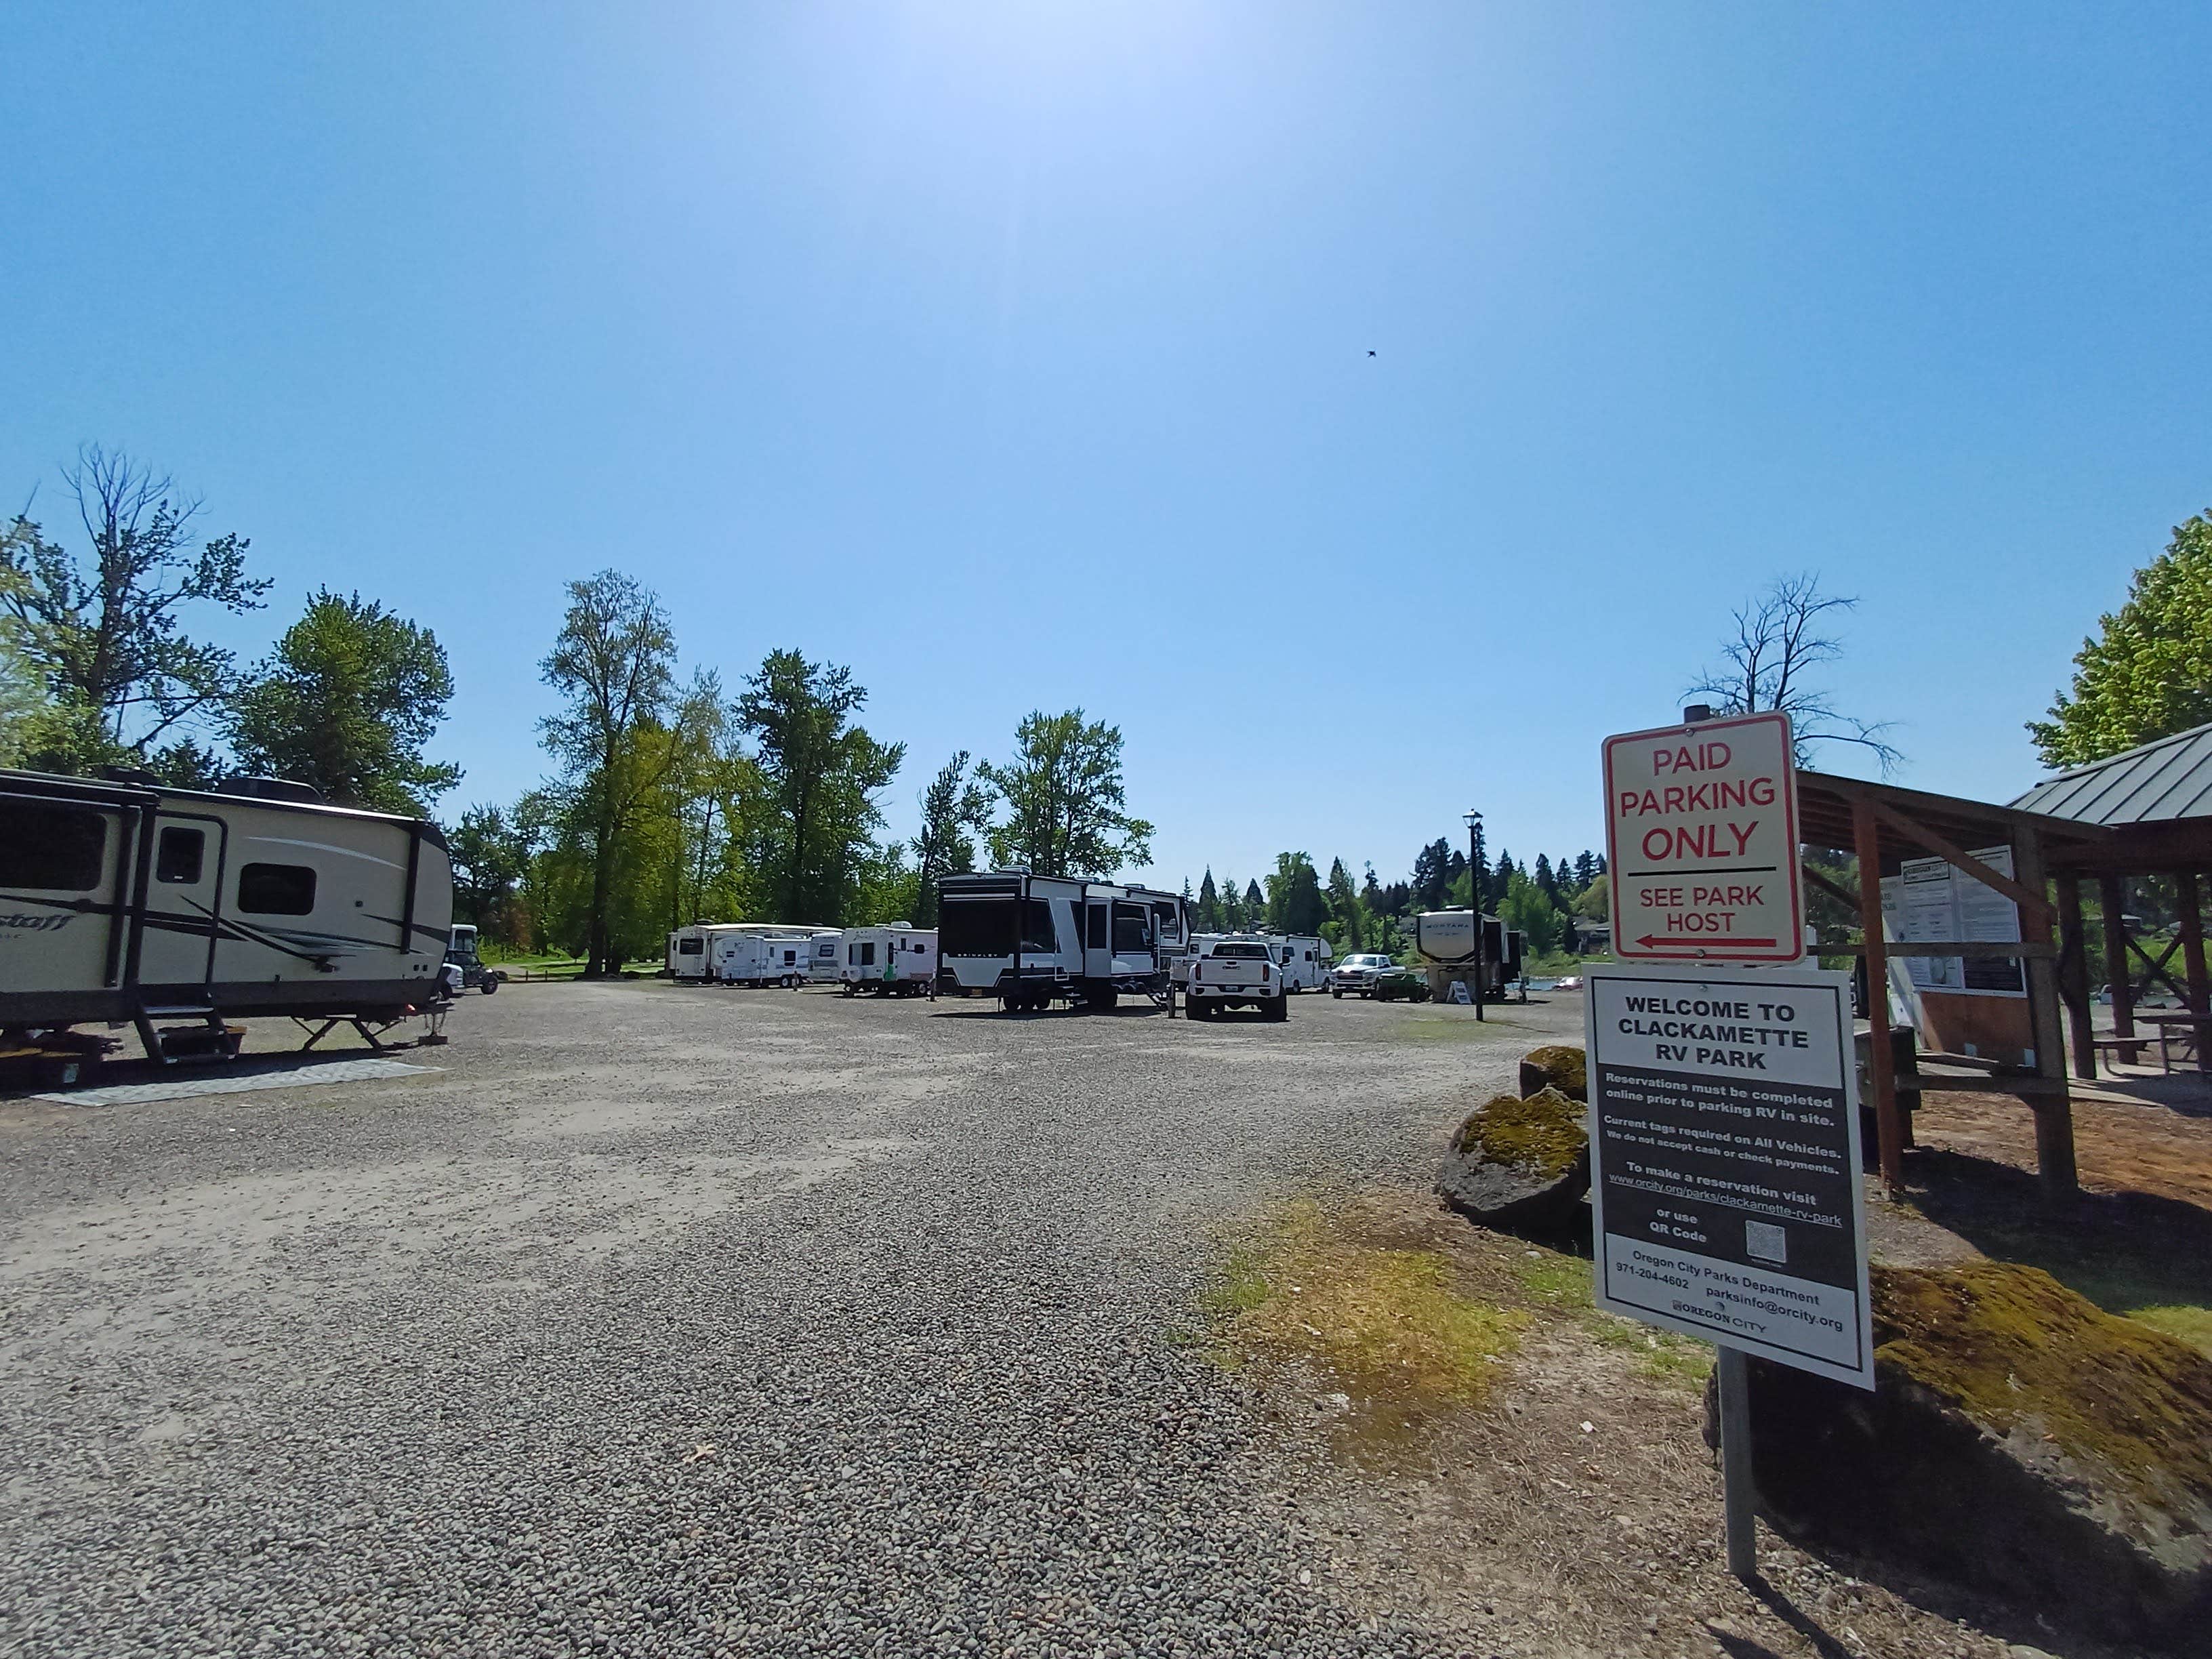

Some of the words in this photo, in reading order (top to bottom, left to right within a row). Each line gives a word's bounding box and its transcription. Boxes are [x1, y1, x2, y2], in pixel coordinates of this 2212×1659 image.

[1654, 742, 1732, 776] PAID
[1620, 777, 1775, 817] PARKING
[1642, 821, 1759, 861] ONLY
[1640, 888, 1683, 907] SEE
[1693, 885, 1764, 906] PARK
[1668, 912, 1735, 932] HOST
[1626, 996, 1750, 1019] WELCOME
[1757, 1003, 1795, 1022] TO
[1618, 1018, 1809, 1048] CLACKAMETTE
[1656, 1044, 1688, 1061] RV
[1696, 1048, 1767, 1069] PARK
[1605, 1073, 1688, 1091] Reservations
[1692, 1084, 1726, 1096] must
[1730, 1087, 1748, 1098] be
[1752, 1091, 1832, 1109] completed
[1606, 1089, 1643, 1101] online
[1647, 1094, 1677, 1105] prior
[1681, 1098, 1695, 1108] to
[1698, 1101, 1752, 1118] parking
[1756, 1107, 1777, 1118] RV
[1781, 1110, 1796, 1122] in
[1799, 1113, 1835, 1127] site.
[1604, 1115, 1647, 1129] Current
[1650, 1122, 1677, 1134] tags
[1679, 1127, 1732, 1142] required
[1734, 1136, 1751, 1145] on
[1755, 1137, 1773, 1148] All
[1776, 1140, 1842, 1159] Vehicles.
[1607, 1130, 1622, 1140] We
[1624, 1133, 1637, 1141] do
[1638, 1136, 1656, 1145] not
[1657, 1139, 1694, 1151] accept
[1695, 1145, 1721, 1156] cash
[1738, 1152, 1773, 1164] check
[1776, 1158, 1840, 1175] payments.
[1609, 1173, 1843, 1229] www.orcity.org/parks/clackamette-rv-park
[1626, 1161, 1643, 1172] To
[1645, 1166, 1681, 1180] make
[1684, 1174, 1693, 1183] a
[1696, 1178, 1779, 1199] reservation
[1782, 1191, 1817, 1206] visit
[1649, 1222, 1670, 1234] QR
[1672, 1227, 1708, 1243] Code
[1656, 1209, 1671, 1218] or
[1673, 1212, 1699, 1224] use
[1633, 1250, 1674, 1269] Oregon
[1677, 1262, 1701, 1277] City
[1704, 1268, 1739, 1285] Parks
[1742, 1277, 1820, 1306] Department
[1616, 1262, 1690, 1290] 971-204-4602
[1706, 1288, 1843, 1332] parksinfo@orcity.org
[1683, 1304, 1730, 1324] OREGON
[1732, 1317, 1767, 1333] CITY
